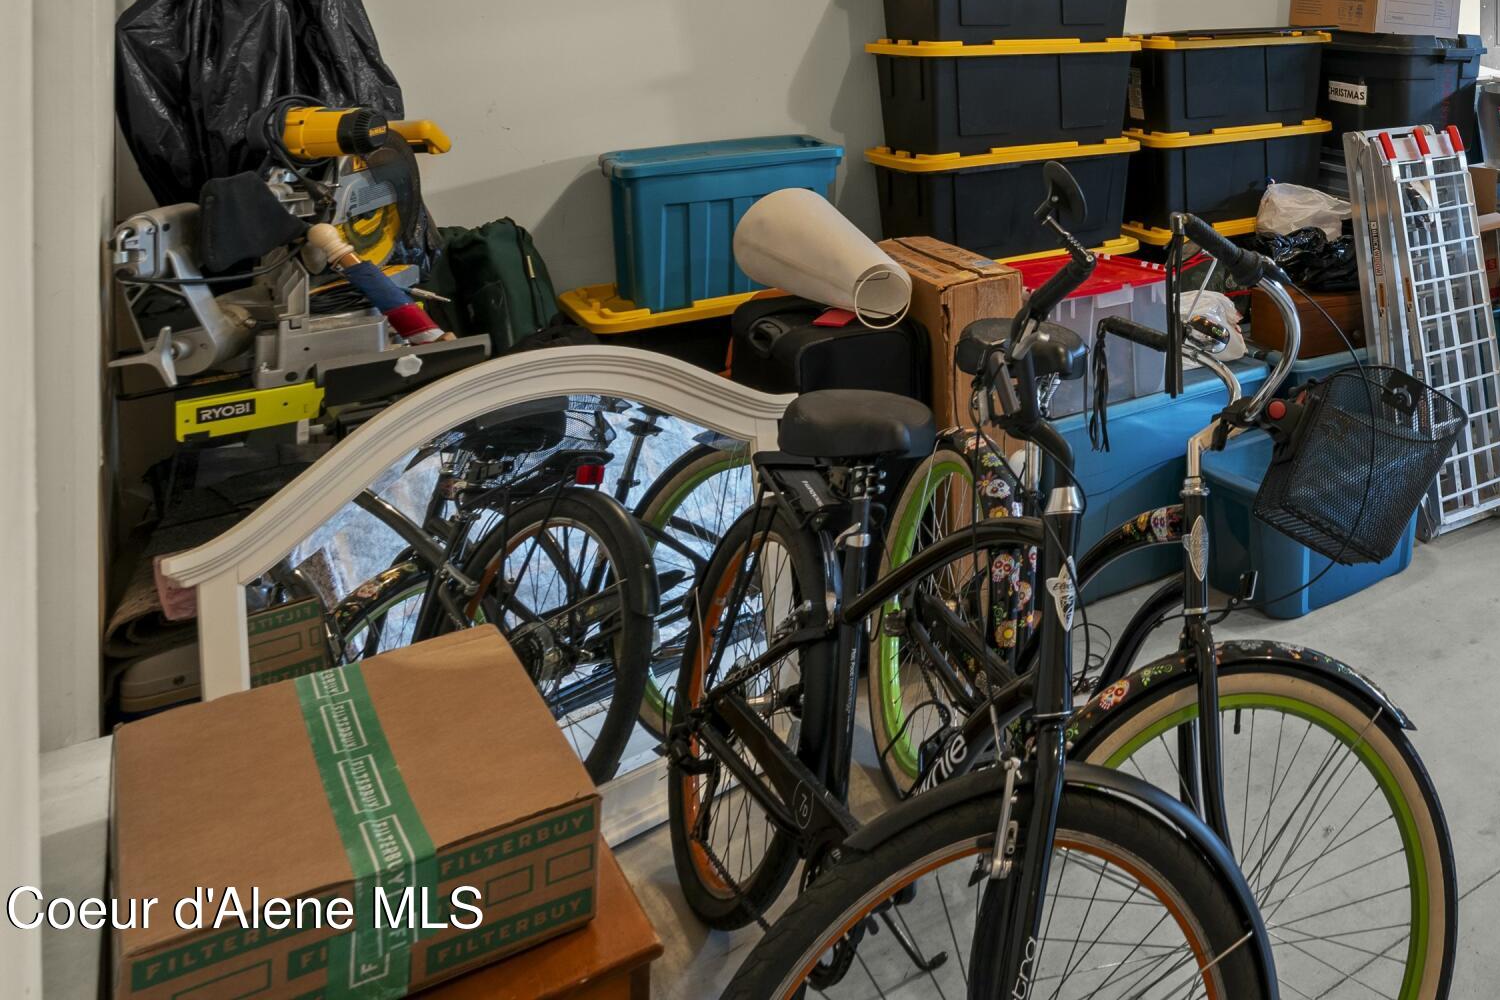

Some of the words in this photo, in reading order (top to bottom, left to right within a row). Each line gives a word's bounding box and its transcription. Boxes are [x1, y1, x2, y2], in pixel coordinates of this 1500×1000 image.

[201, 402, 251, 421] RYOBI
[440, 815, 585, 876] FILTERBUY
[437, 898, 582, 964] FILTERBUY
